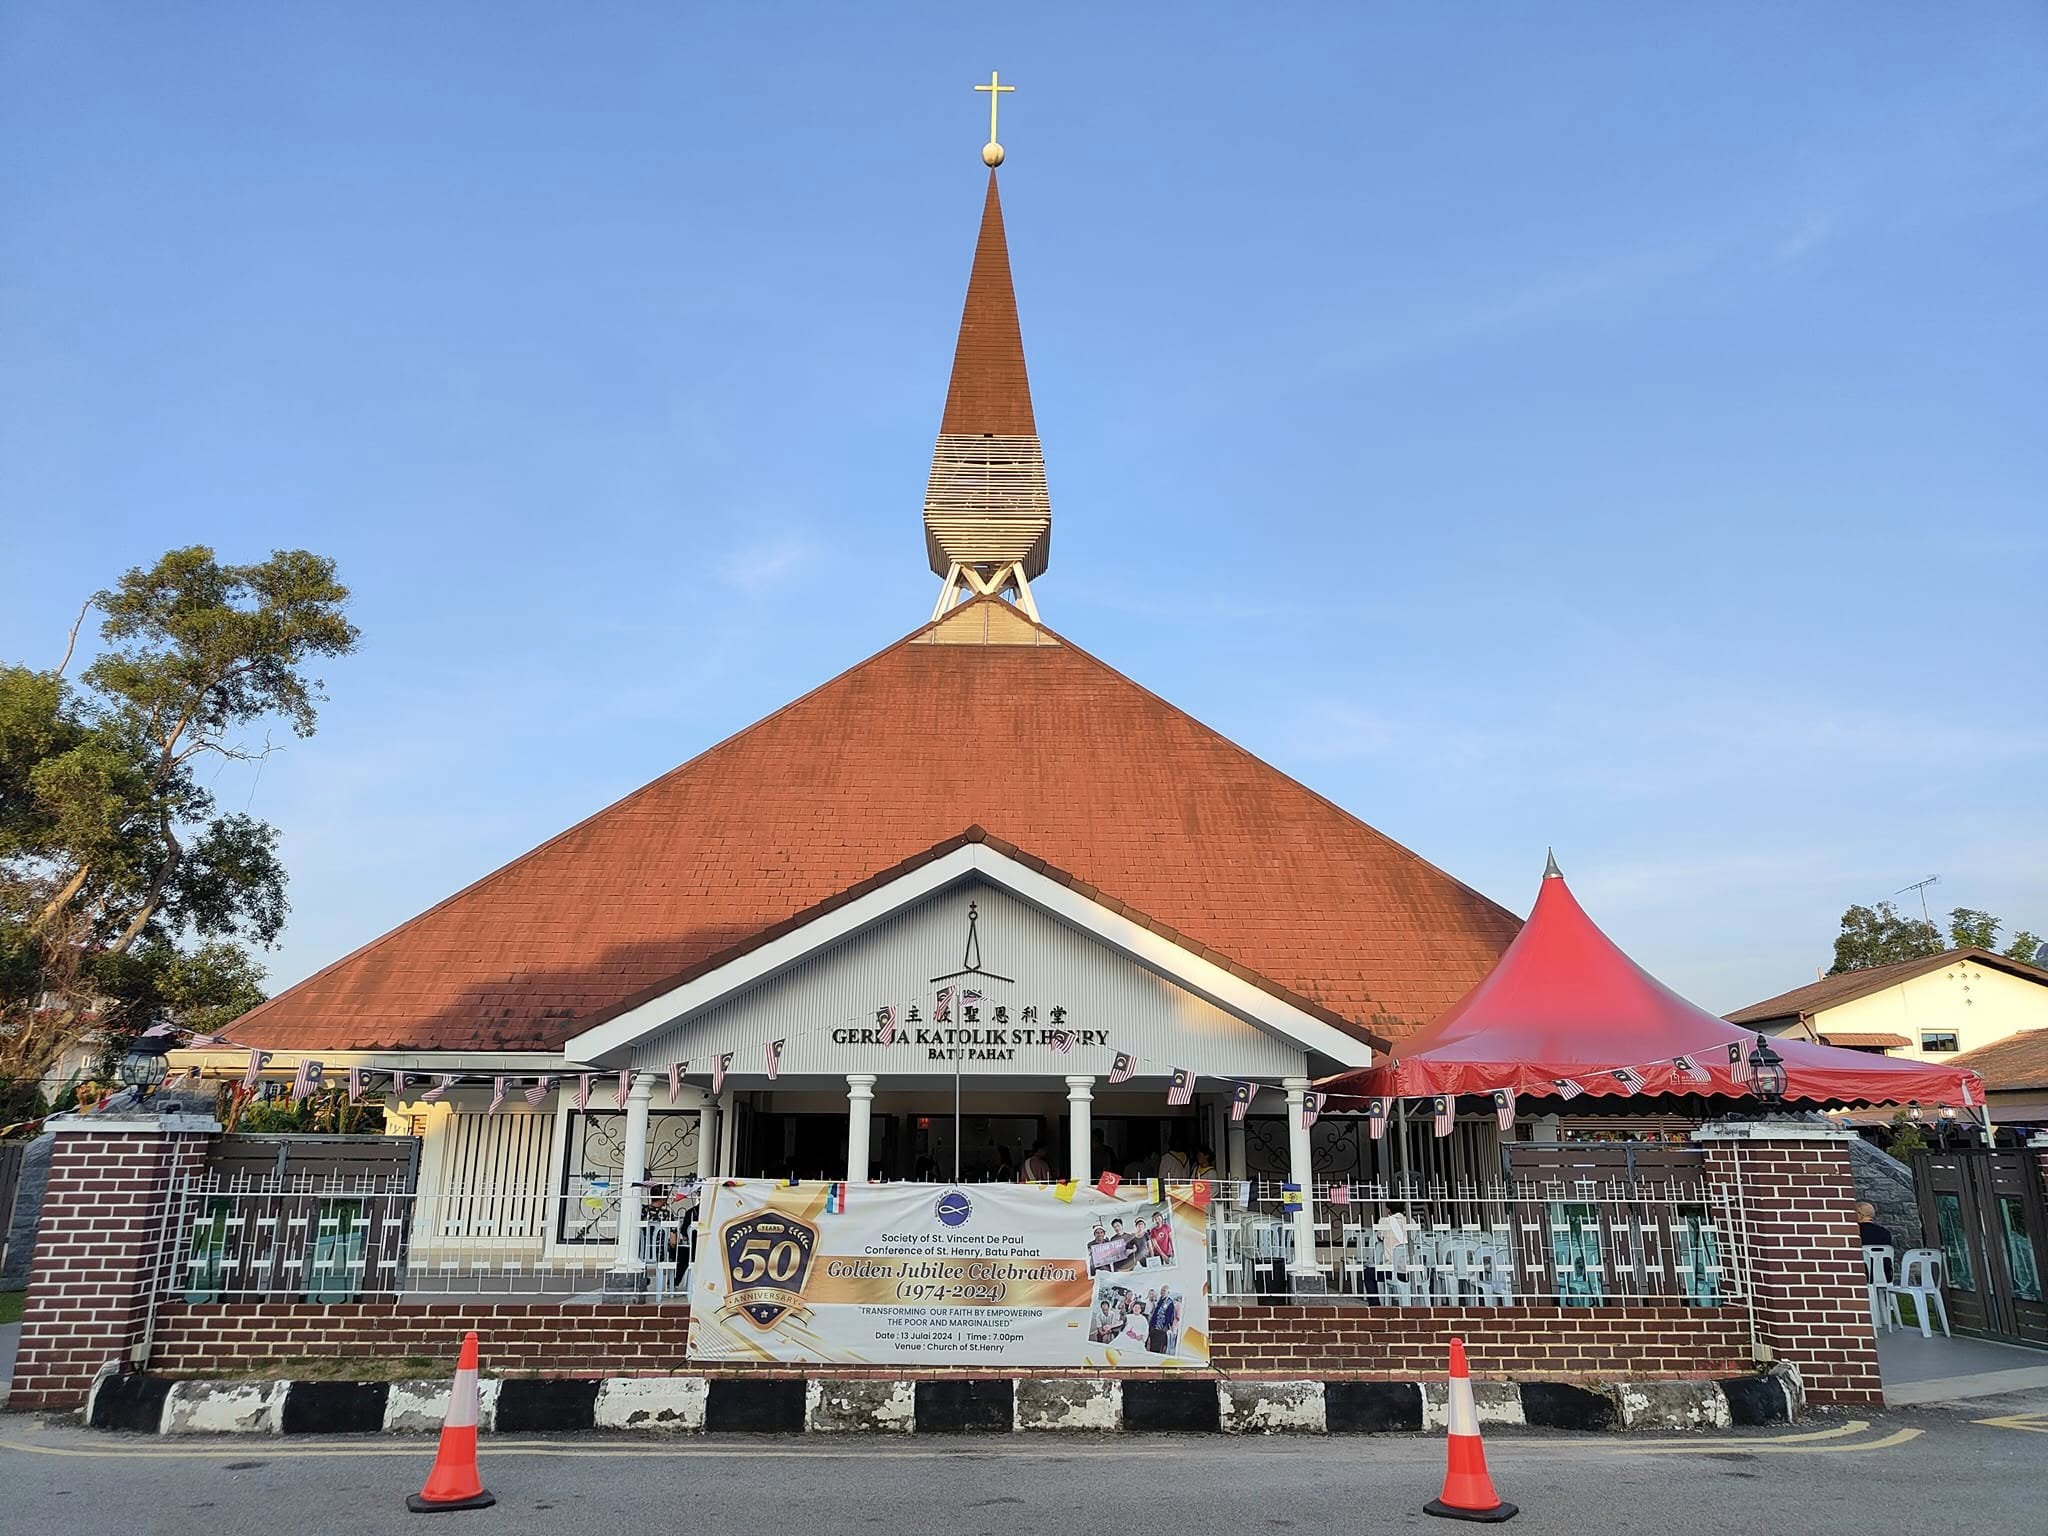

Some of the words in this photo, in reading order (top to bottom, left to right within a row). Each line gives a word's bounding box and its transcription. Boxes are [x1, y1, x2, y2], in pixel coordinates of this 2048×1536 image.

[916, 1028, 1007, 1045] KATOLIK
[928, 1048, 965, 1060] BATU
[968, 1048, 1015, 1060] PAHAT
[881, 1232, 918, 1245] Society
[920, 1233, 930, 1243] of
[932, 1234, 945, 1243] St.
[946, 1234, 985, 1244] Vincent
[986, 1235, 1000, 1244] De
[1002, 1235, 1024, 1244] Paul
[864, 1245, 923, 1255] Conference
[924, 1246, 935, 1255] of
[936, 1247, 949, 1256] St.
[951, 1247, 983, 1258] Henry,
[985, 1247, 1008, 1256] Batu
[1010, 1248, 1041, 1257] Pahat
[732, 1239, 801, 1282] 50
[828, 1260, 893, 1278] Golden
[896, 1262, 963, 1279] Jubilee
[968, 1263, 1076, 1281] Celebration
[896, 1281, 1007, 1302] (1974-2024)
[733, 1292, 799, 1304] ANNIVERSARY
[929, 1308, 948, 1316] OUR
[949, 1308, 973, 1317] FAITH
[974, 1309, 985, 1317] BY
[986, 1309, 1043, 1317] EMPOWERING
[888, 1318, 903, 1326] THE
[904, 1318, 928, 1326] POOR
[929, 1319, 948, 1327] AND
[901, 1332, 909, 1340] 13
[910, 1332, 931, 1340] Julai
[932, 1332, 953, 1340] 2024
[992, 1333, 1025, 1343] 7.00pm
[927, 1343, 958, 1351] Church
[959, 1343, 968, 1351] of
[969, 1343, 1005, 1354] St.Henry
